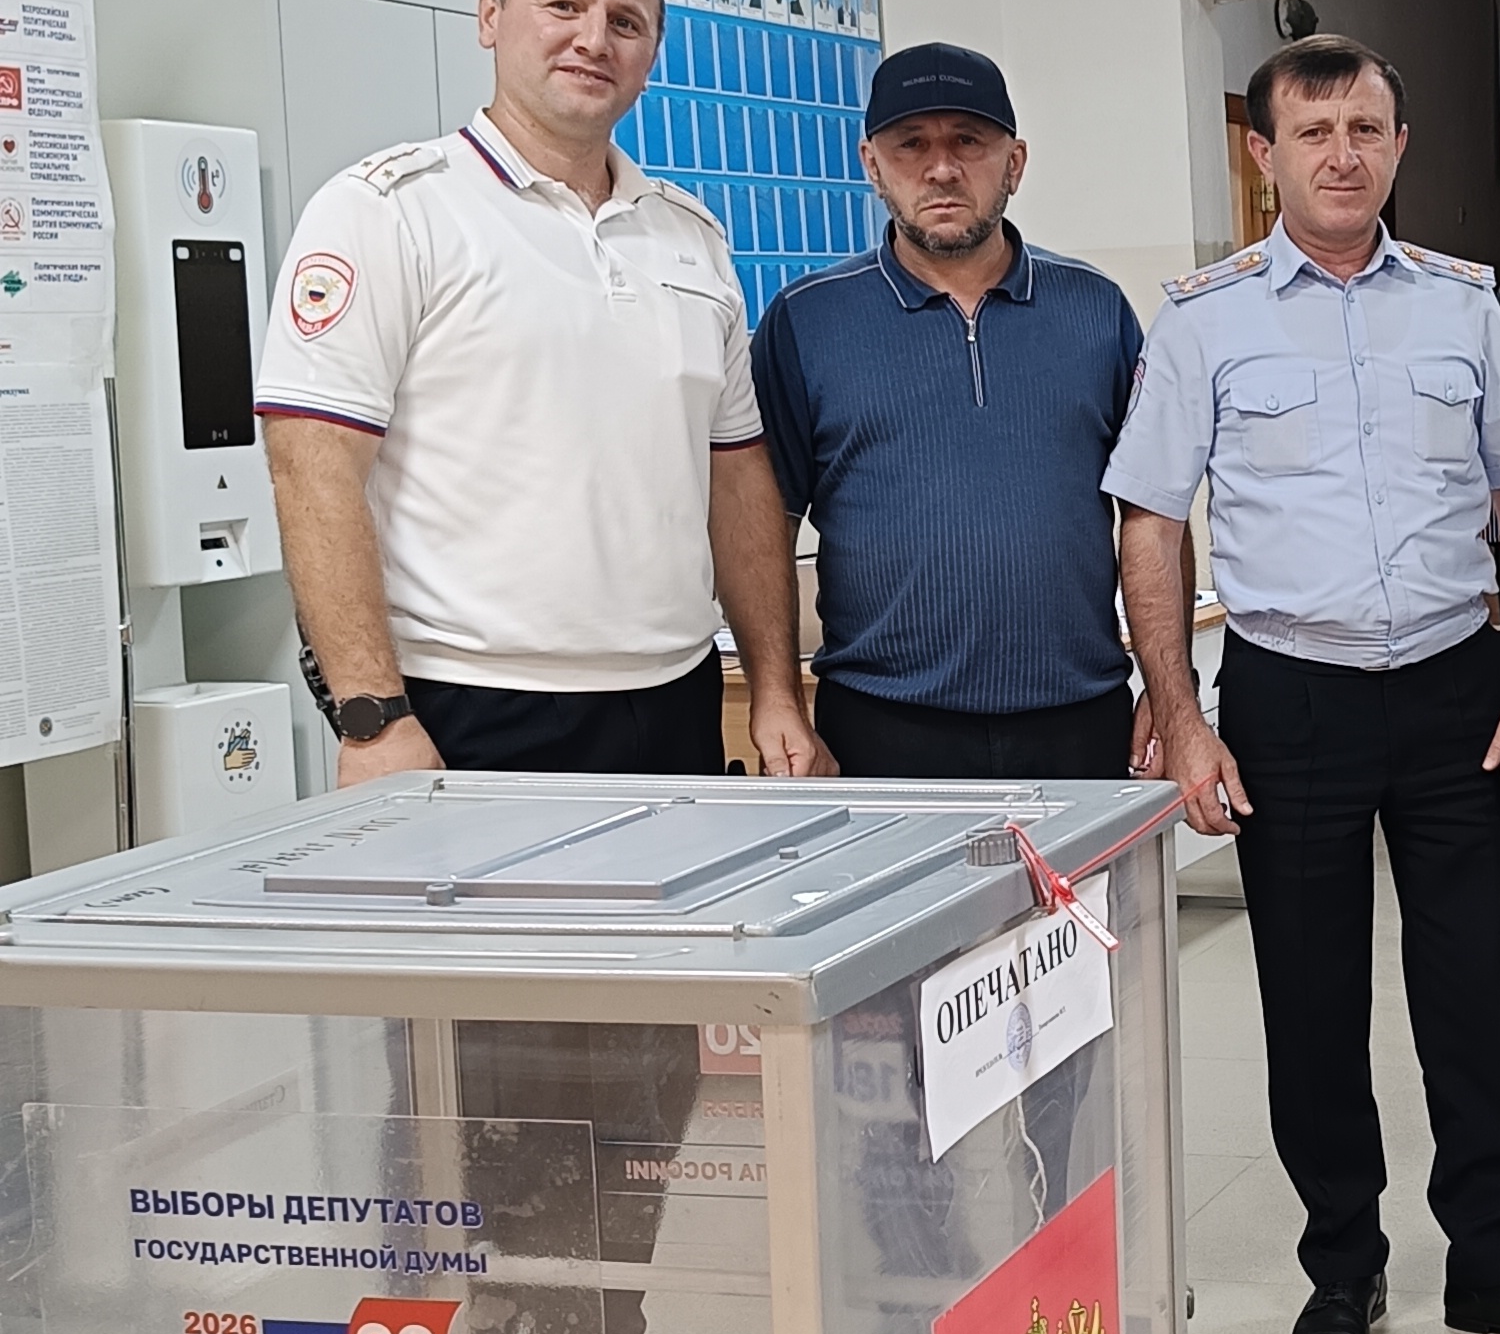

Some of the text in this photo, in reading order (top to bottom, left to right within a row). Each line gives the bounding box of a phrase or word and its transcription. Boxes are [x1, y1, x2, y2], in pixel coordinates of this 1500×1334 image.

[937, 920, 1077, 1044] ОПЕЧАТАНО
[130, 1188, 483, 1228] ВЫБОРЫ ДЕПУТАТОВ
[133, 1238, 488, 1275] ГОСУДАРСТВЕННОЙ ДУМЫ
